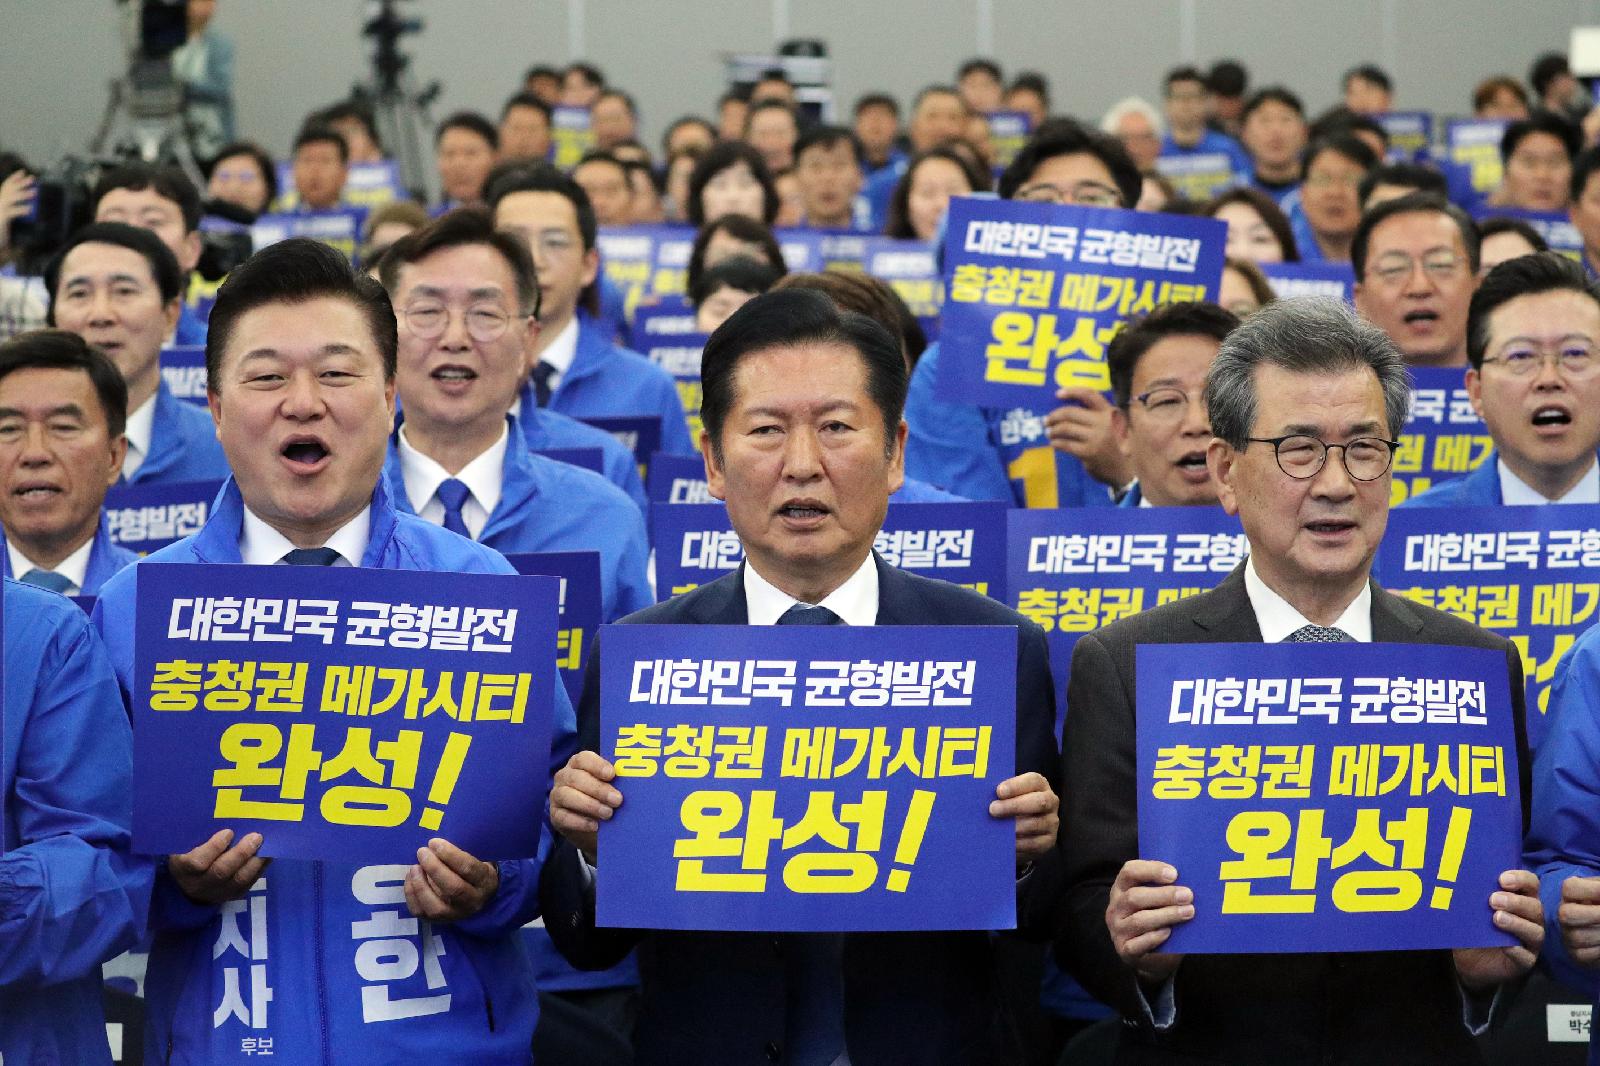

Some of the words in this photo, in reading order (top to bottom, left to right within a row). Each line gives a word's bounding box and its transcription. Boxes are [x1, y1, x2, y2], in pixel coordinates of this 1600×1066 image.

[964, 221, 1078, 261] 대한민국
[1079, 229, 1201, 272] 균형발전
[951, 264, 1055, 308] 충청권
[1008, 446, 1059, 509] 1
[1028, 534, 1167, 573] 대한민국
[1173, 534, 1250, 572] 균형
[1404, 531, 1540, 572] 대한민국
[168, 597, 339, 645] 대한민국
[347, 601, 517, 652] 균형발전
[150, 660, 308, 712] 충청권
[320, 666, 531, 723] 메가시티
[629, 659, 797, 706] 대한민국
[805, 659, 976, 706] 균형발전
[1169, 678, 1342, 725] 대한민국
[1350, 677, 1487, 725] 균형발전
[213, 723, 472, 830] 완성!
[614, 724, 768, 778] 충청권
[780, 726, 992, 778] 메가시티
[1152, 744, 1315, 799] 충청권
[1328, 744, 1506, 796] 메가시티
[673, 790, 936, 893] 완성!
[1219, 806, 1472, 913] 완성!
[213, 877, 273, 1028] 지사
[241, 1037, 273, 1055] 후보
